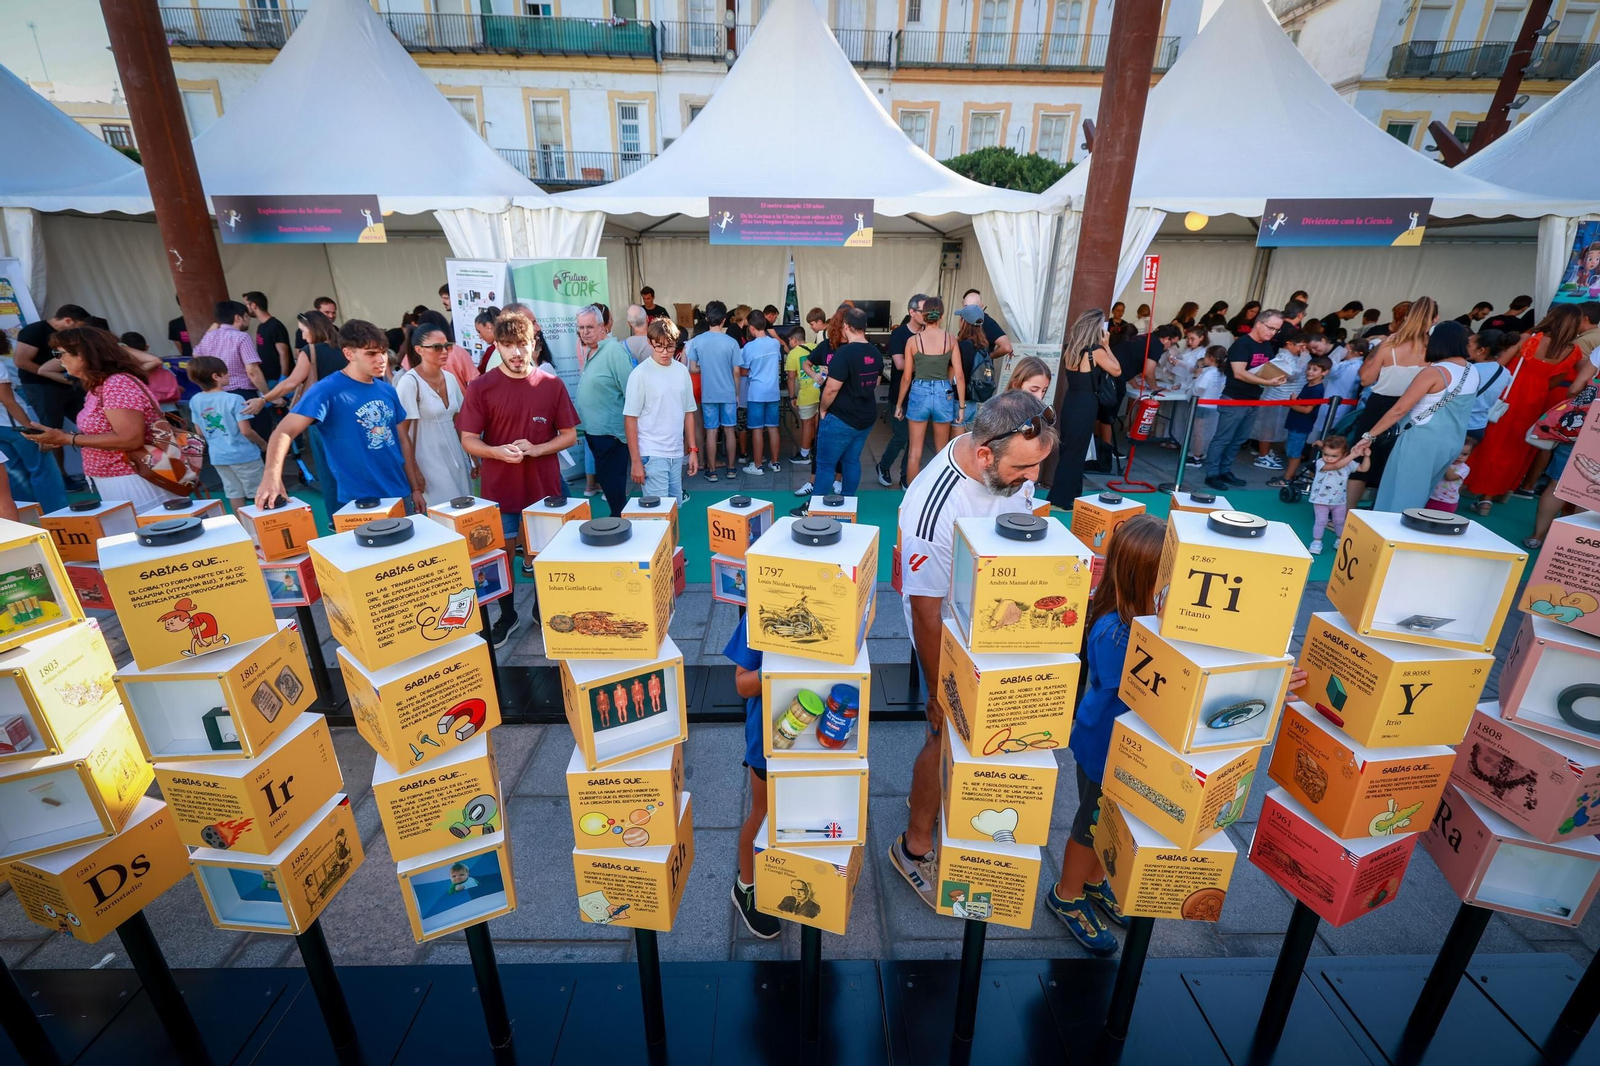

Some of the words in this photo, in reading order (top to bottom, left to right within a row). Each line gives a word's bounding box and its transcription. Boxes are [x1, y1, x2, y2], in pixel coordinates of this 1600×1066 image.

[1301, 217, 1339, 226] Diviértete
[1365, 216, 1393, 225] Ciencia
[561, 272, 588, 282] Future
[51, 528, 91, 545] Tm
[712, 520, 736, 542] Sm
[1190, 555, 1216, 564] 47.867
[1337, 537, 1358, 581] Sc
[1552, 558, 1590, 571] PRODUCTOS
[1554, 552, 1597, 566] PROCEDENTE
[140, 563, 189, 580] SABÍAS
[192, 557, 228, 568] QUE...
[375, 564, 414, 581] SABÍAS
[417, 557, 446, 568] QUE...
[758, 566, 783, 578] 1797
[991, 567, 1017, 577] 1801
[1281, 567, 1293, 575] 22
[1547, 570, 1577, 580] CIMIENTO
[138, 583, 169, 594] COBALTO
[170, 577, 192, 587] FORMA
[194, 572, 214, 581] PARTE
[391, 572, 434, 588] TRANSFUSIONES
[392, 585, 416, 596] EMPLEAN
[417, 576, 442, 587] LIGANDOS
[444, 571, 460, 579] LLAMA-
[432, 580, 451, 589] FORMAN
[548, 573, 575, 582] 1778
[131, 591, 164, 602] BALAMINA
[165, 583, 201, 595] (VITAMINA
[792, 582, 816, 591] Vauquelin
[1188, 568, 1243, 613] Ti
[133, 597, 168, 608] FICIENCIA
[168, 592, 190, 601] PUEDE
[191, 584, 224, 595] PROVOCAR
[379, 605, 398, 613] HIERRO
[400, 594, 430, 607] COMPLEJOS
[372, 607, 409, 623] ESTABILIDAD
[1179, 608, 1210, 620] Titanio
[374, 619, 395, 629] EVITAR
[376, 626, 394, 635] QUEDE
[378, 633, 394, 642] SIADO
[398, 625, 416, 634] HIERRO
[1323, 630, 1349, 650] SABÍAS
[1351, 647, 1372, 665] QUE...
[38, 659, 58, 678] 1803
[240, 663, 258, 682] 1803
[1130, 644, 1167, 697] Zr
[1182, 668, 1190, 677] 40
[1402, 670, 1431, 678] 88.90585
[405, 671, 440, 692] SABÍAS
[442, 662, 470, 674] QUE...
[1000, 675, 1032, 684] SABÍAS
[1035, 673, 1060, 681] QUE...
[1127, 676, 1146, 697] Circonio
[1398, 683, 1433, 716] Y
[1290, 719, 1309, 735] 1907
[1386, 718, 1401, 727] Itrio
[1472, 730, 1497, 748] Humphry
[1476, 721, 1503, 741] 1808
[1122, 735, 1142, 751] 1923
[255, 768, 271, 784] 192.2
[974, 771, 1006, 779] SABÍAS
[1009, 773, 1035, 781] QUE...
[1382, 765, 1411, 774] SABÍAS
[172, 777, 201, 786] SABÍAS
[203, 781, 226, 789] QUE...
[399, 778, 436, 792] SABÍAS
[439, 772, 467, 781] QUE...
[588, 778, 620, 786] SABÍAS
[260, 774, 294, 817] Ir
[150, 819, 164, 830] 110
[269, 809, 288, 828] Iridio
[1272, 809, 1291, 827] 1961
[1434, 796, 1462, 854] Ra
[291, 848, 309, 869] 1982
[592, 861, 621, 870] SABÍAS
[765, 854, 786, 866] 1967
[960, 855, 991, 865] SABÍAS
[994, 861, 1019, 869] QUE...
[1156, 854, 1188, 862] SABÍAS
[1190, 856, 1214, 864] QUE...
[76, 862, 96, 878] (281)
[83, 853, 151, 908] Ds
[95, 881, 143, 917] Darmstadio
